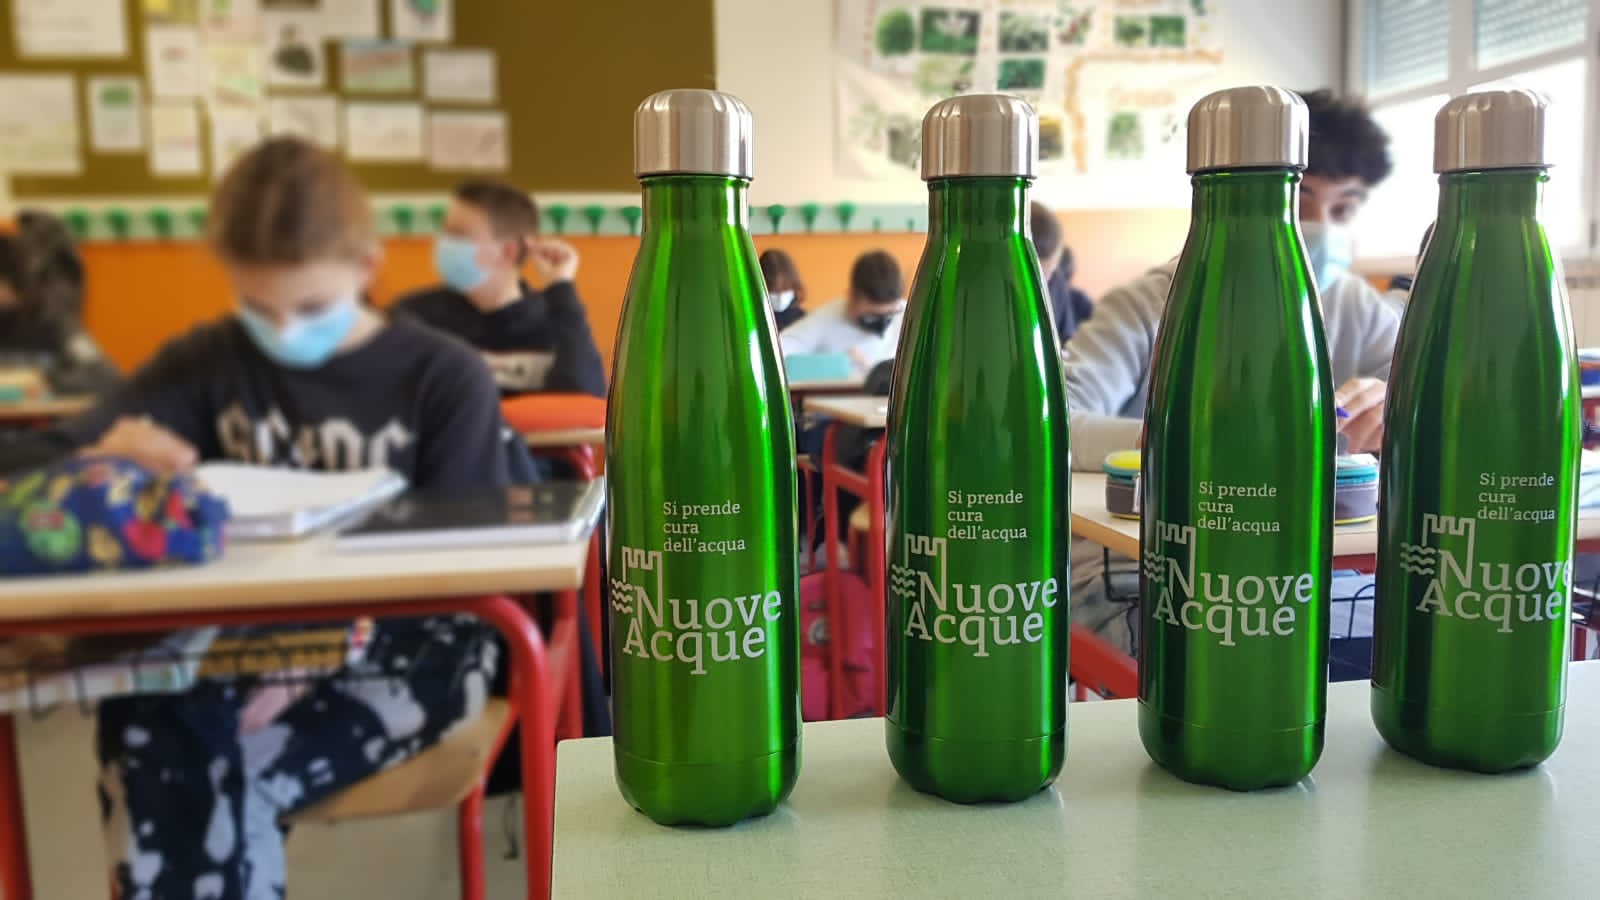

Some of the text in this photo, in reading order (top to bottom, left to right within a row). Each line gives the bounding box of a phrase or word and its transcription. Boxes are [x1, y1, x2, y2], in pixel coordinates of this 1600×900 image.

[1479, 472, 1555, 489] Si prende
[947, 489, 1024, 507] Si prende
[1199, 481, 1277, 499] Si prende
[1478, 492, 1516, 504] cura
[663, 500, 741, 519] Si prende
[947, 510, 983, 522] cura
[1198, 502, 1235, 514] cura
[1477, 506, 1555, 524] dell'acqua
[663, 522, 699, 534] cura
[947, 525, 1028, 542] dell'acqua
[1197, 516, 1281, 535] dell'acqua
[663, 537, 746, 555] dell'acqua
[1166, 557, 1314, 605] Nuove
[917, 570, 1058, 615] Nuove
[633, 585, 782, 631] Nuove
[1416, 578, 1562, 633] Acque
[1152, 586, 1296, 646] Acque
[904, 601, 1045, 657] Acque
[622, 617, 765, 675] Acque
